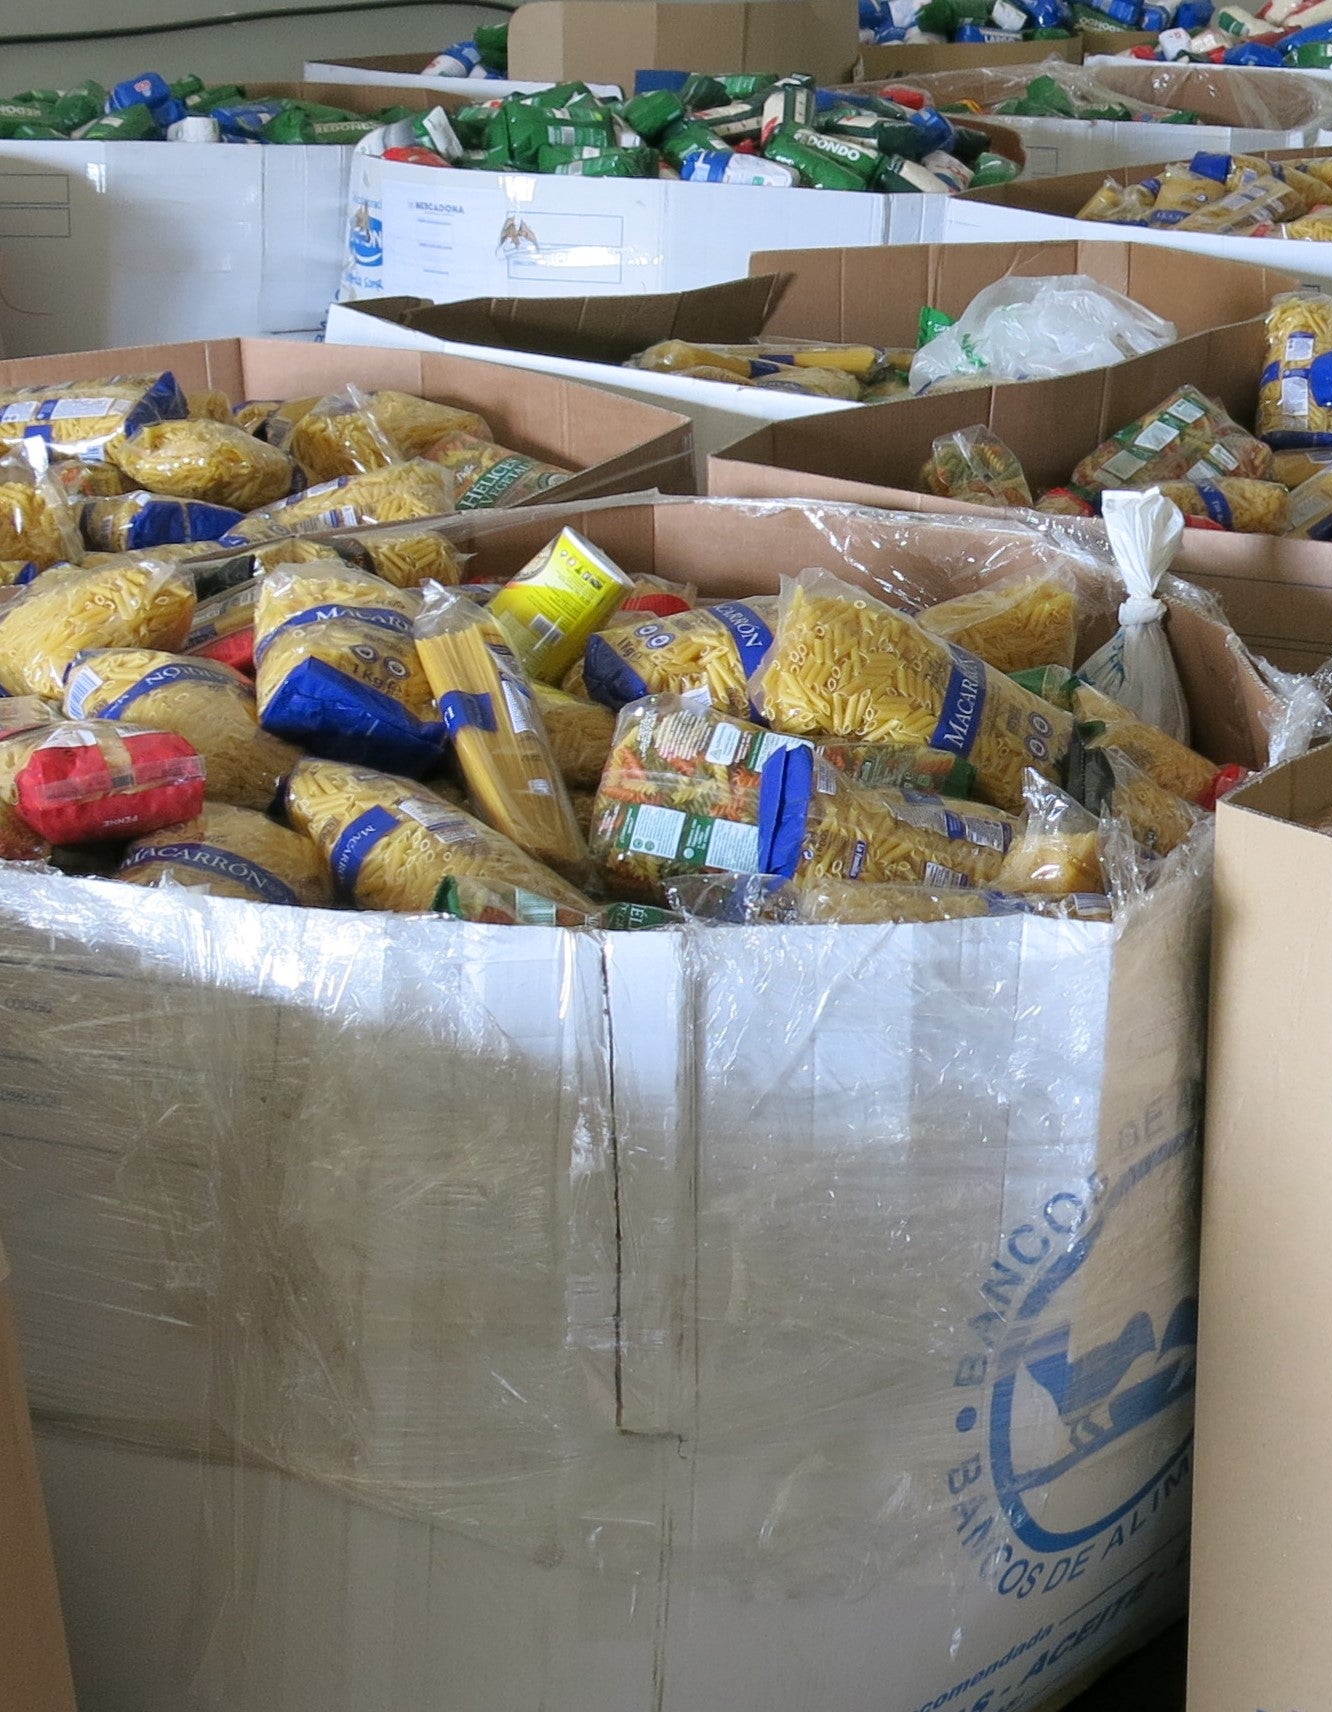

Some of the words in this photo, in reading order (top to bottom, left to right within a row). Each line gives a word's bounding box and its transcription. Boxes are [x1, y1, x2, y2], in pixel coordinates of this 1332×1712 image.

[714, 604, 763, 648] CARRÓN
[103, 815, 138, 827] PENNE
[121, 846, 268, 889] MACARRÓN
[1042, 1543, 1097, 1595] DE
[1102, 1455, 1190, 1560] ALIM
